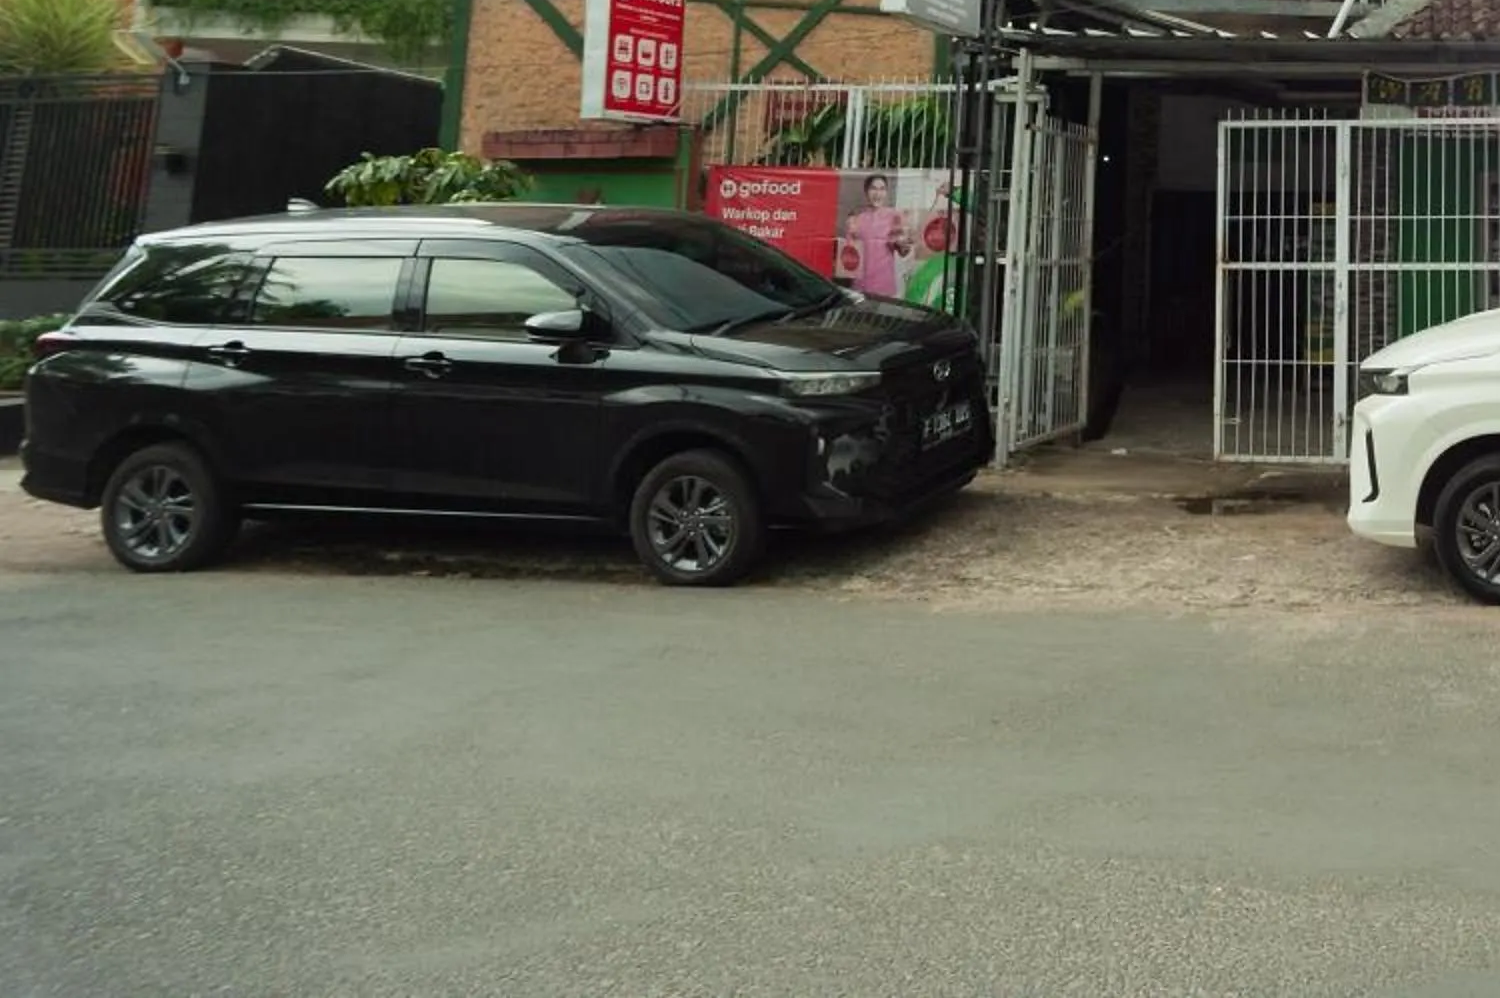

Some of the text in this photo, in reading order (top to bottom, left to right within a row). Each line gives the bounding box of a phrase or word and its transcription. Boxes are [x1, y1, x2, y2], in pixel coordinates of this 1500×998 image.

[739, 180, 801, 198] gofood
[722, 207, 797, 223] Warkop dan
[748, 225, 785, 239] Bakar
